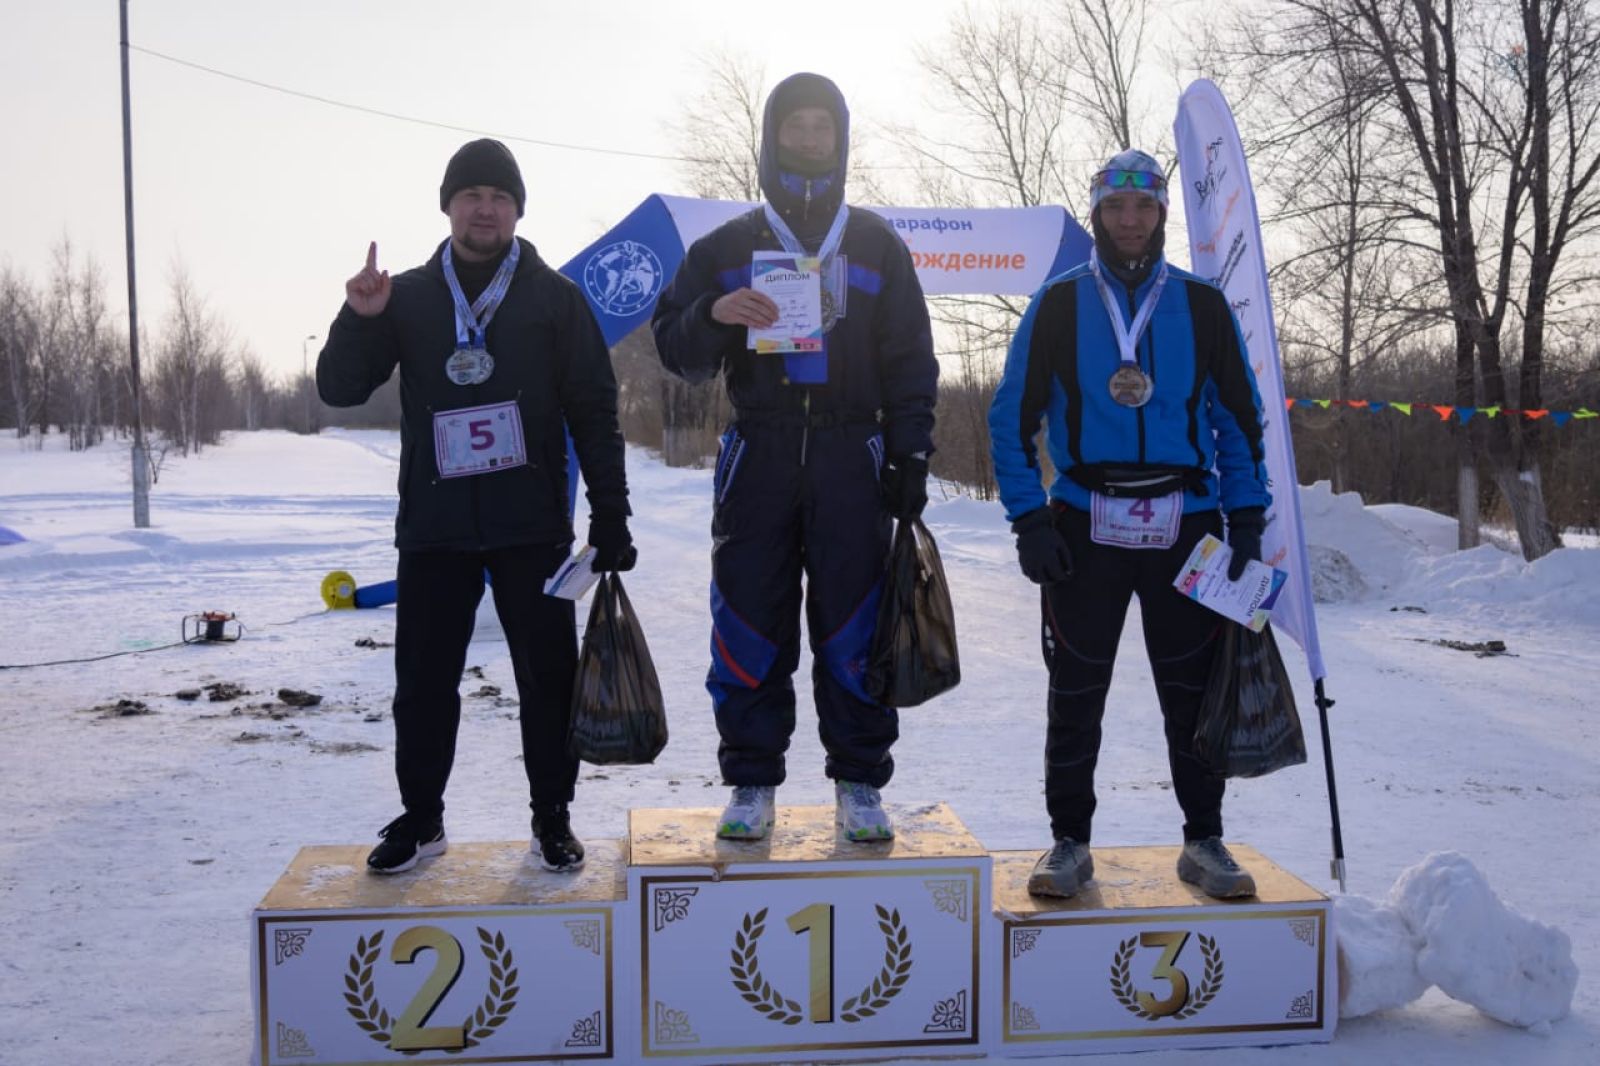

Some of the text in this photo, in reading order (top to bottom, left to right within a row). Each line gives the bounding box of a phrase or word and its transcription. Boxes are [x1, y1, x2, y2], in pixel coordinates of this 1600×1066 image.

[765, 272, 810, 284] ДИПЛОМ
[469, 419, 495, 451] 5
[1128, 497, 1155, 523] 4
[1247, 576, 1270, 617] ДИПЛОМ
[785, 903, 835, 1024] 1
[1136, 931, 1192, 1019] 3
[389, 926, 467, 1052] 2
